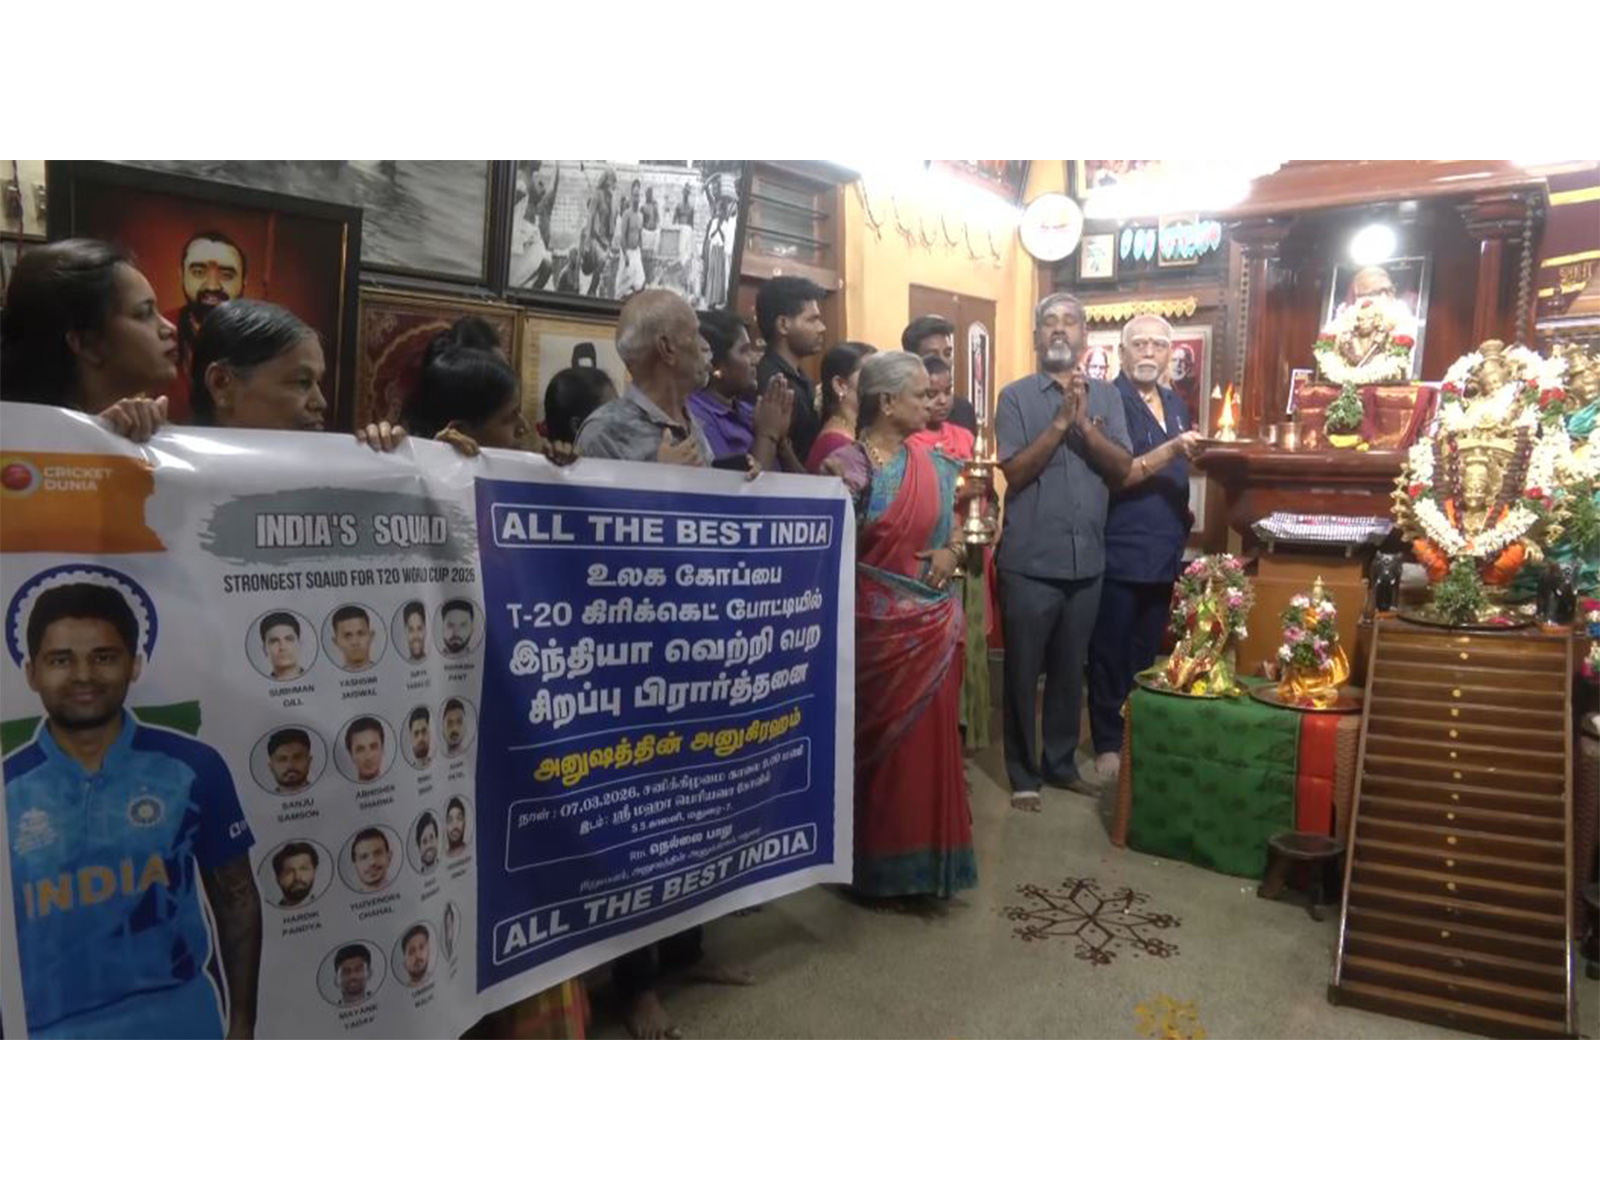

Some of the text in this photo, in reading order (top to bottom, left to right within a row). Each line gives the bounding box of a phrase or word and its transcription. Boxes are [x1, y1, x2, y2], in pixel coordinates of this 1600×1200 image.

[43, 466, 112, 479] CRICKET
[44, 479, 98, 491] DUNIA
[255, 514, 447, 548] INDIA'S SQUAD
[501, 512, 827, 545] ALL THE BEST INDIA
[223, 572, 302, 594] STRONGEST
[306, 569, 348, 589] SQAUD
[351, 568, 374, 587] FOR
[376, 567, 400, 585] T20
[429, 566, 449, 583] CUP
[451, 566, 476, 583] 2026
[586, 560, 782, 588] உலக கோப்பை
[507, 588, 822, 628] T-20 கிரிக்கெட் போட்டியில்
[509, 623, 821, 681] இந்தியா வெற்றி பெற
[528, 661, 808, 728] சிறப்பு பிரார்த்தனை
[534, 707, 802, 786] அனுஷத்தின் அனுகிரஹம்
[23, 852, 170, 919] INDIA
[503, 911, 569, 955] ALL
[584, 884, 653, 926] THE
[662, 858, 733, 903] BEST
[738, 831, 809, 871] INDIA
